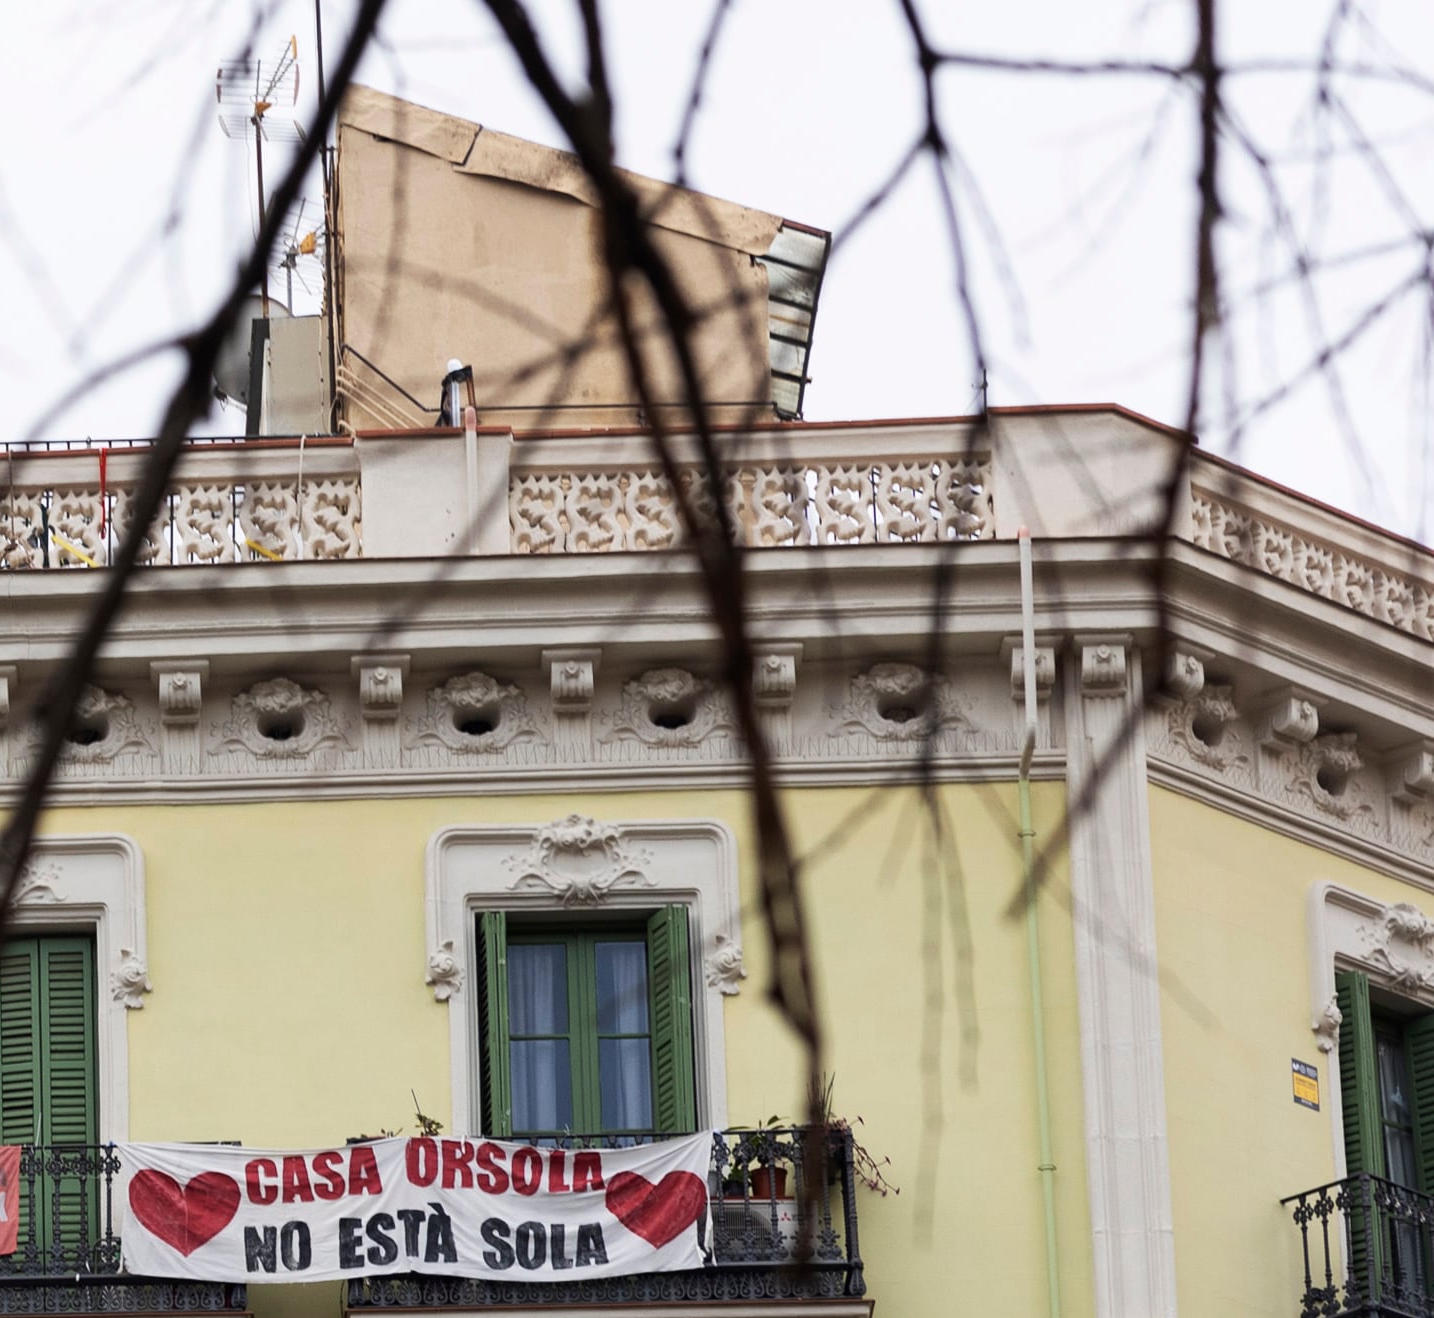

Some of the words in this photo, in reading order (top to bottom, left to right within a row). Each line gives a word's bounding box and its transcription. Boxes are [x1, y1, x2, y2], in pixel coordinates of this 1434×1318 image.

[245, 1146, 382, 1205] CASA
[405, 1137, 606, 1196] ORSOLA
[244, 1221, 312, 1273] NO
[339, 1202, 458, 1269] ESTÀ
[481, 1217, 609, 1270] SOLA
